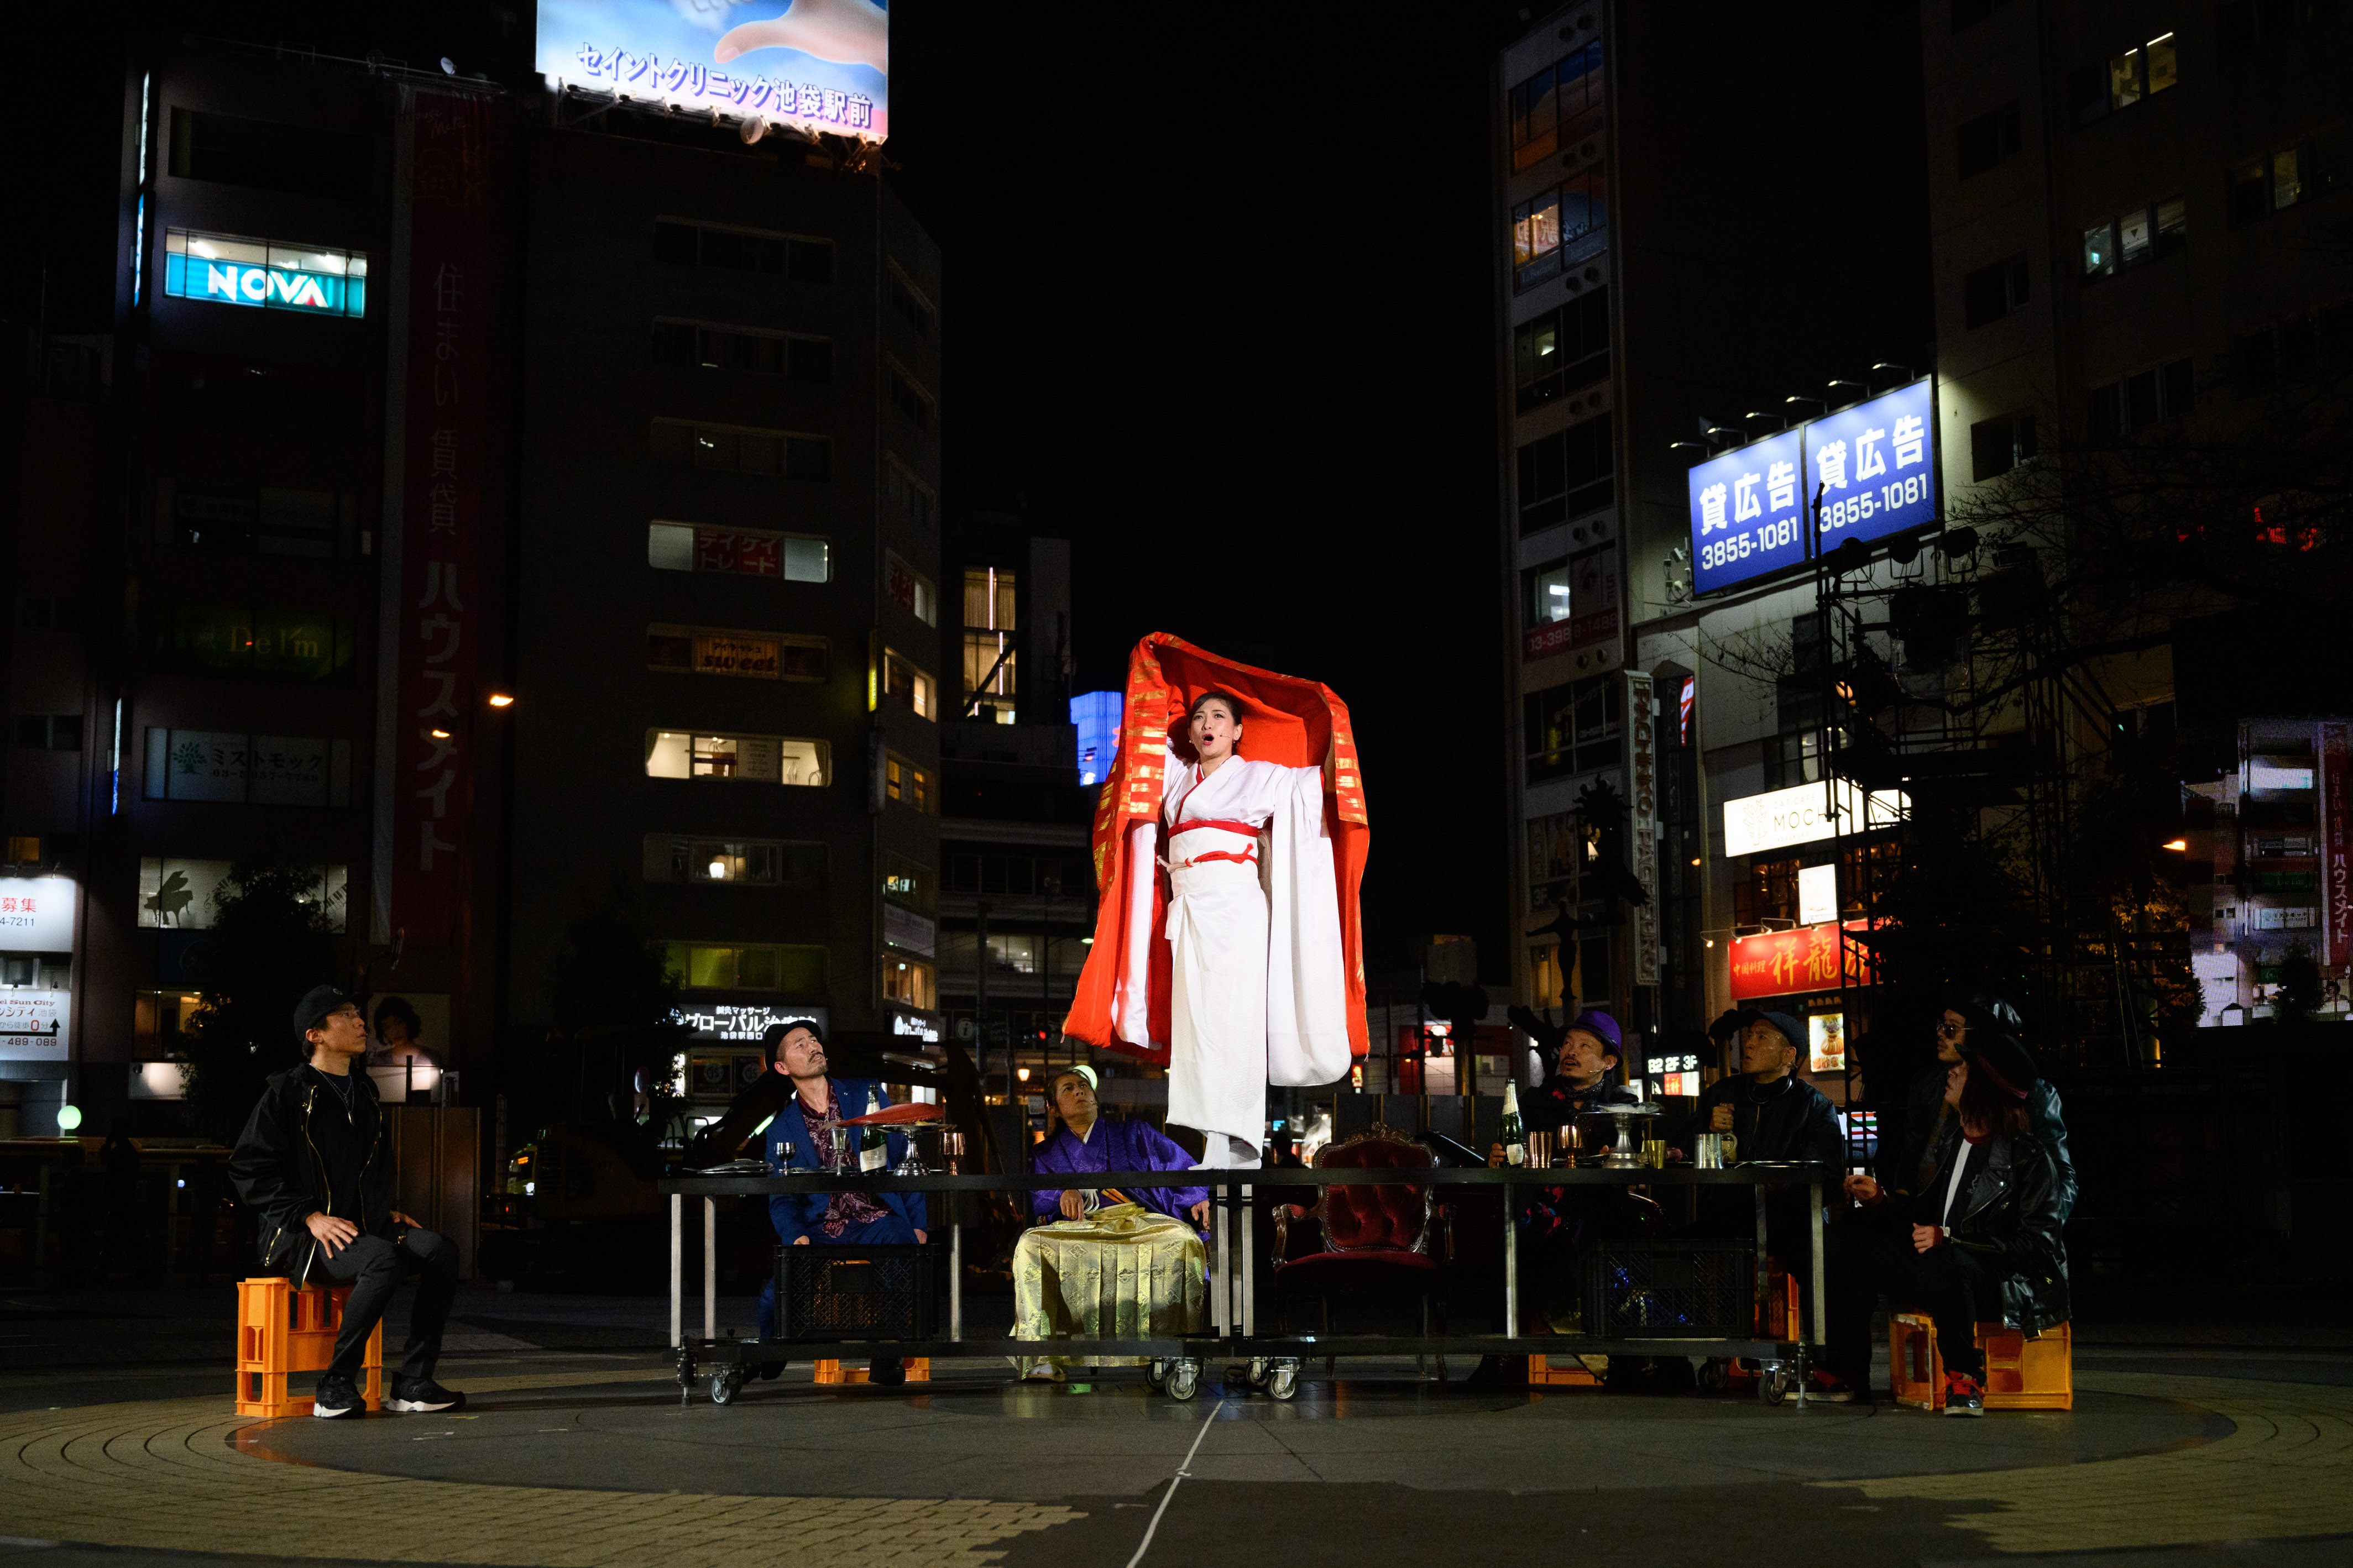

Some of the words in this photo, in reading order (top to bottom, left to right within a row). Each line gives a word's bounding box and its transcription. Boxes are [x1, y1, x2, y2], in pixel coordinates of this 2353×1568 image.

[577, 42, 872, 129] セイントクリニック池袋駅前
[207, 263, 330, 308] NOVA
[1816, 415, 1924, 496] 貸広告
[1699, 460, 1796, 536] 貸広告
[1819, 473, 1927, 533] 3855-1081
[1702, 517, 1798, 570] 3855-1081
[416, 561, 463, 872] ハウスメイト
[212, 748, 323, 770] ミストモック
[1773, 799, 1795, 809] CAT
[1774, 803, 1832, 832] MOCH
[2, 897, 36, 913] 募集
[1733, 959, 1766, 977] 中国料理
[39, 1008, 57, 1017] 池袋
[720, 1031, 764, 1040] 池袋駅西口
[1648, 1058, 1664, 1073] B2
[1665, 1056, 1680, 1072] 2F
[1683, 1055, 1698, 1070] 3F
